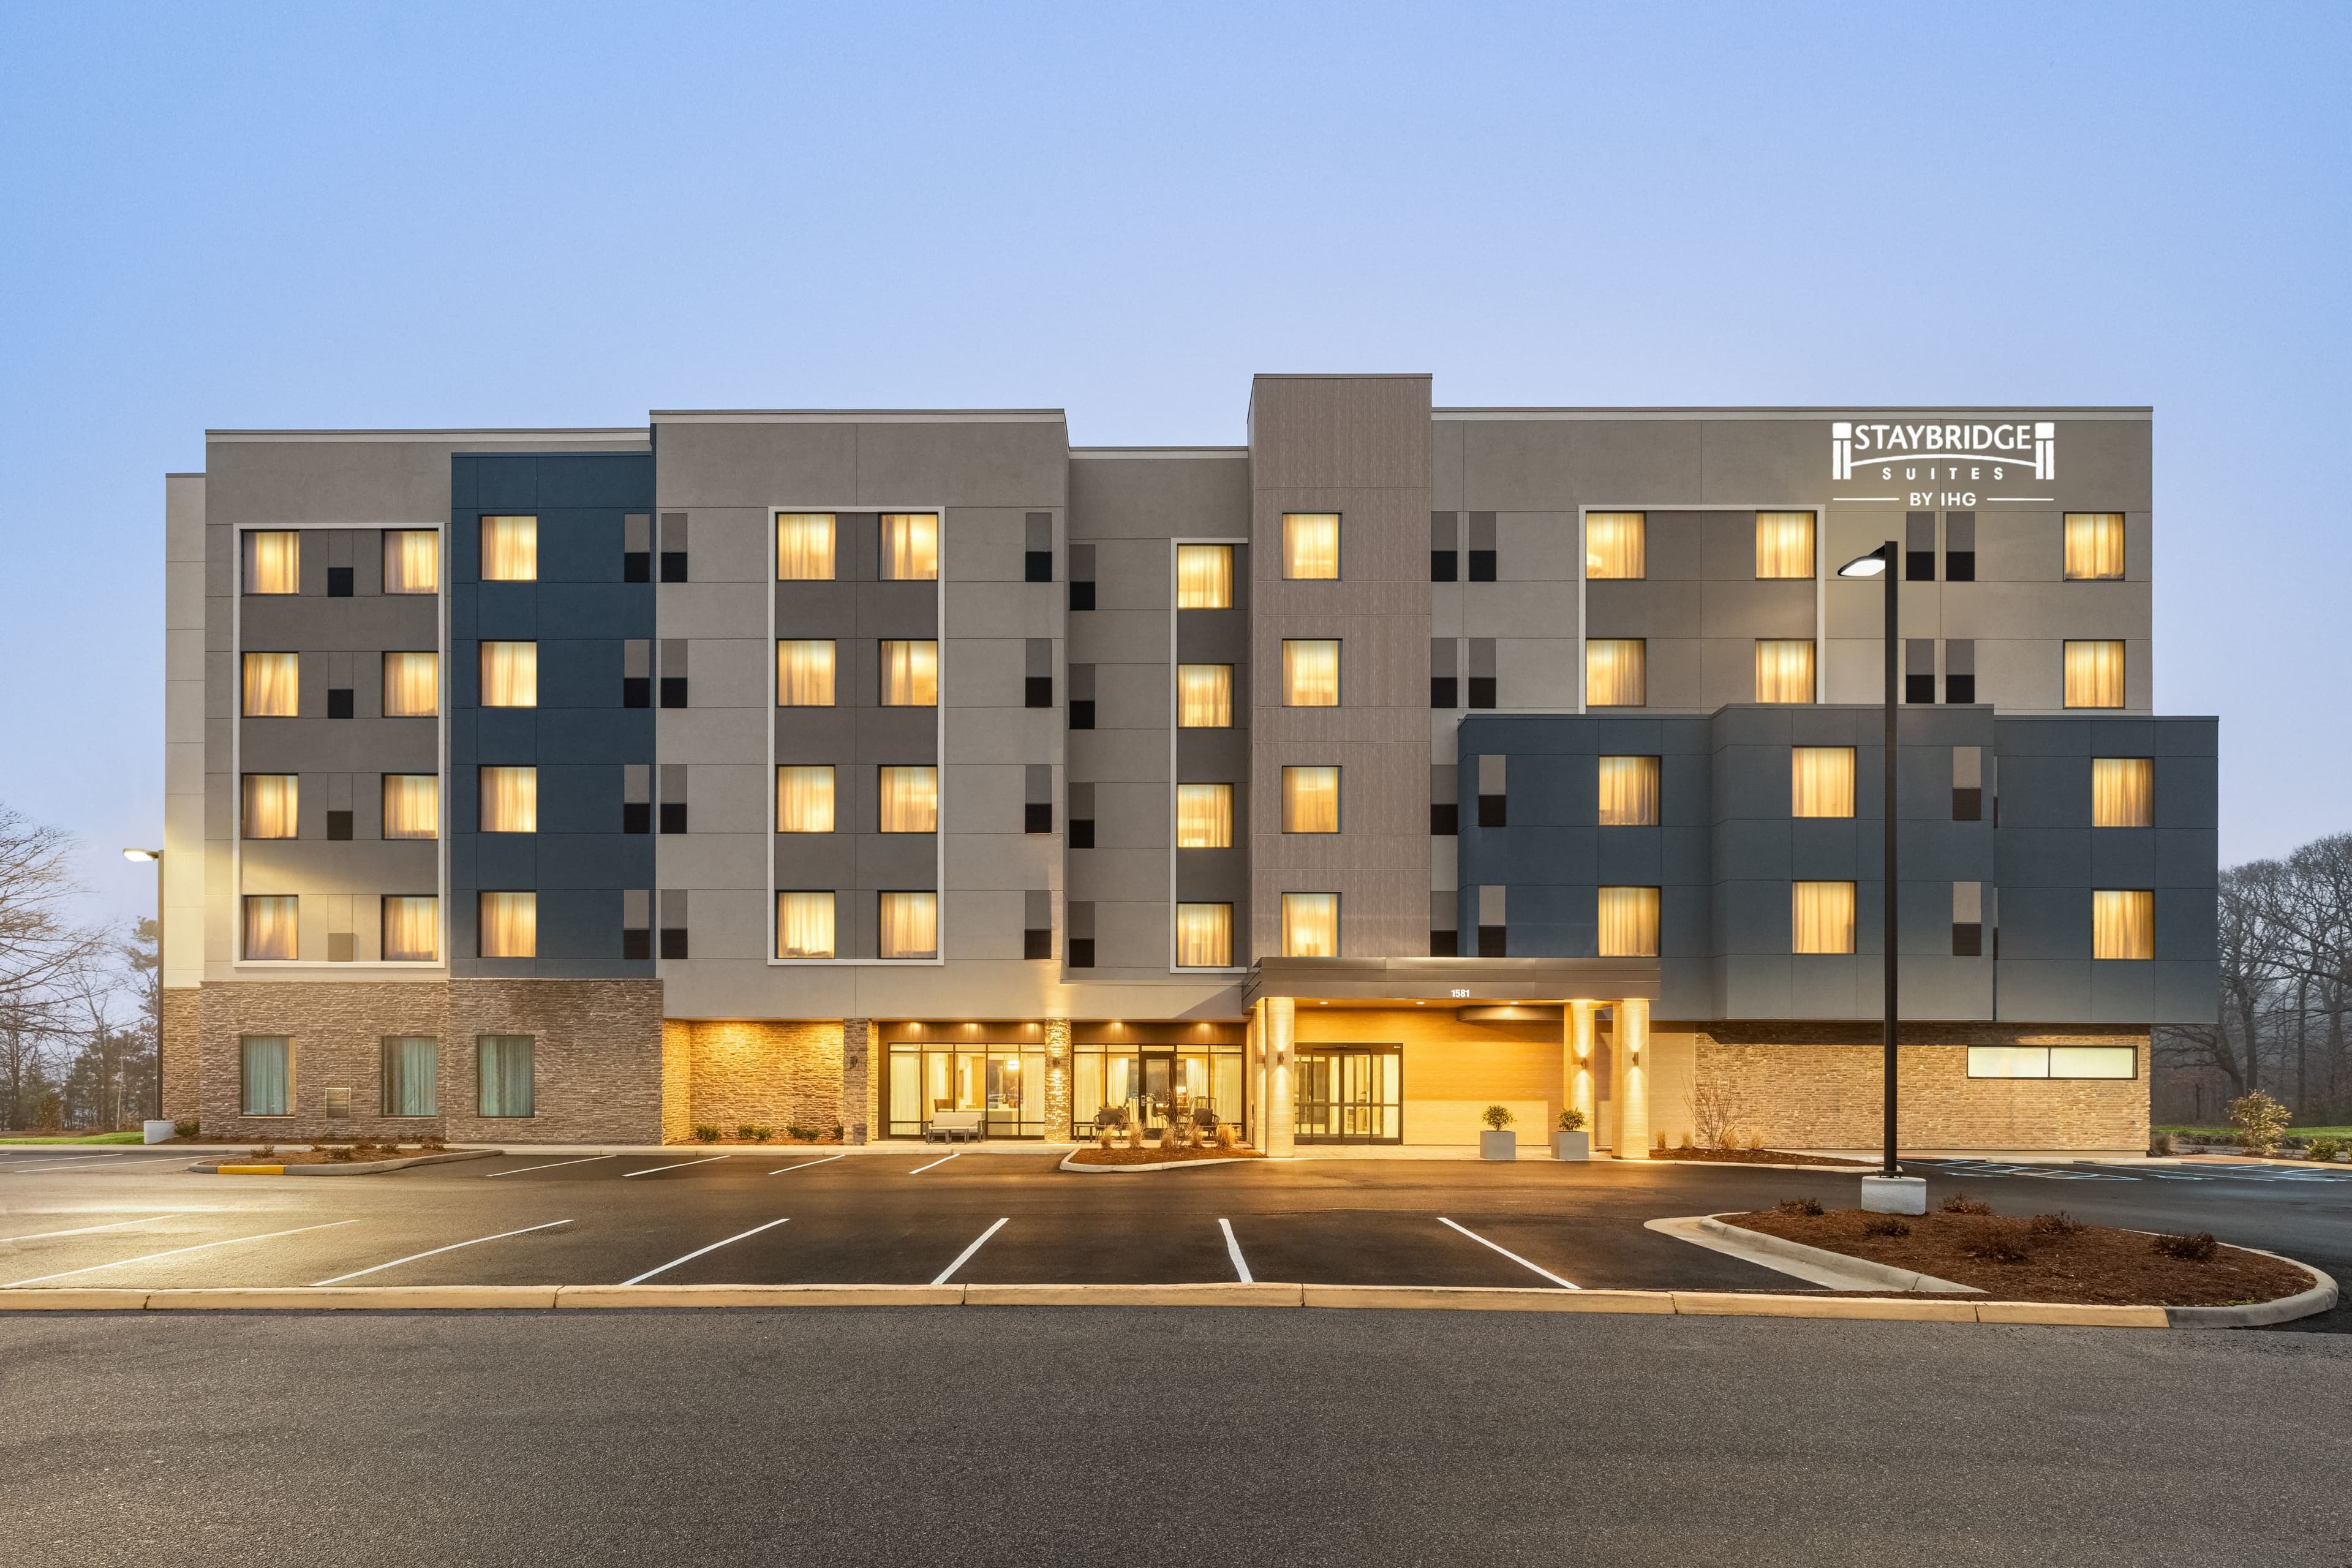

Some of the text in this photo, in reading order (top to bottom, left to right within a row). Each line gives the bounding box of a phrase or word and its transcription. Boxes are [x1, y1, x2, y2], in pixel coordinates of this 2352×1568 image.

[1855, 424, 2032, 450] STAYBRIDGE
[1882, 467, 2003, 480] SUITES
[1910, 492, 1977, 507] BY IHG
[1451, 989, 1470, 998] 1581
